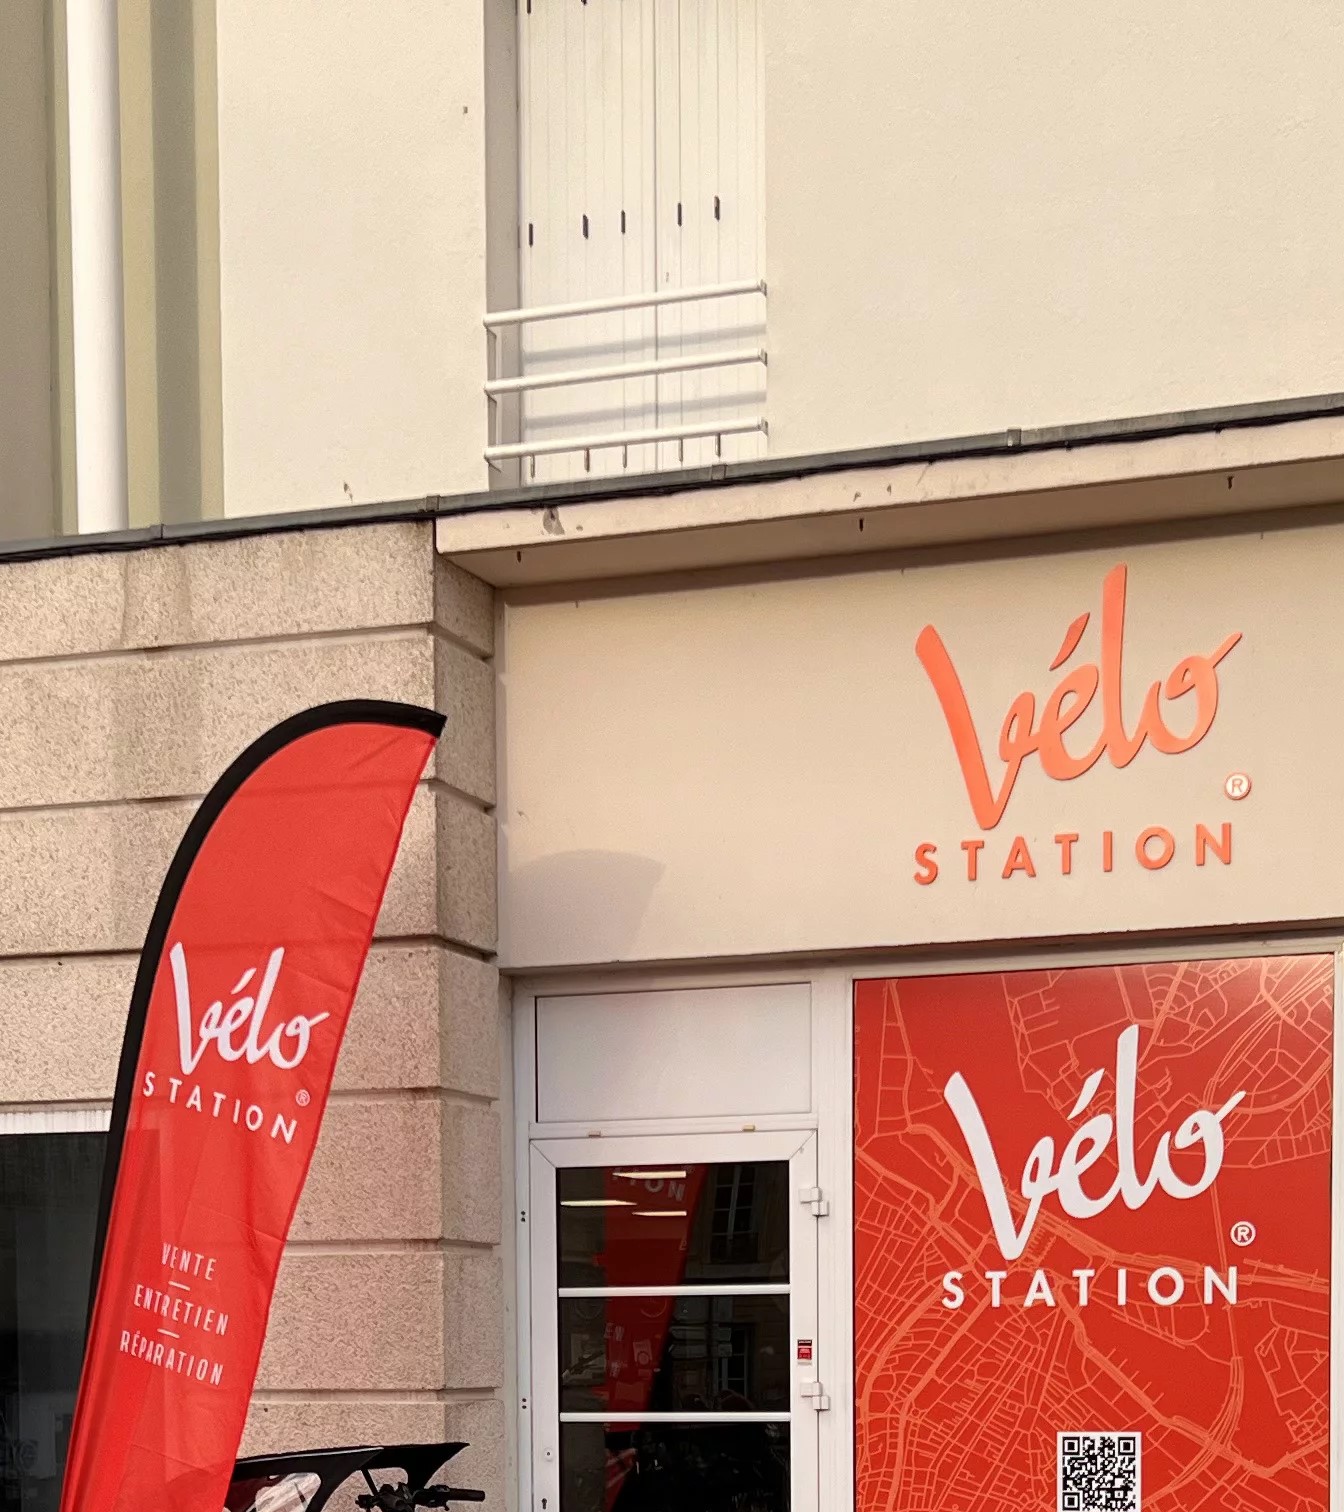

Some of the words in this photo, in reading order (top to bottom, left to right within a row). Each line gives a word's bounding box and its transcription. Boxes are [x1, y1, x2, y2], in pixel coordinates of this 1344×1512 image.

[914, 562, 1243, 830] Vélo
[913, 822, 1232, 886] STATION
[169, 941, 330, 1075] Vélo
[142, 1070, 298, 1145] STATION
[943, 1023, 1247, 1260] Vélo
[161, 1241, 218, 1281] VENTE
[940, 1265, 1238, 1310] STATION
[133, 1284, 229, 1336] ENTRETIEN
[120, 1330, 224, 1387] RÉPARATION
